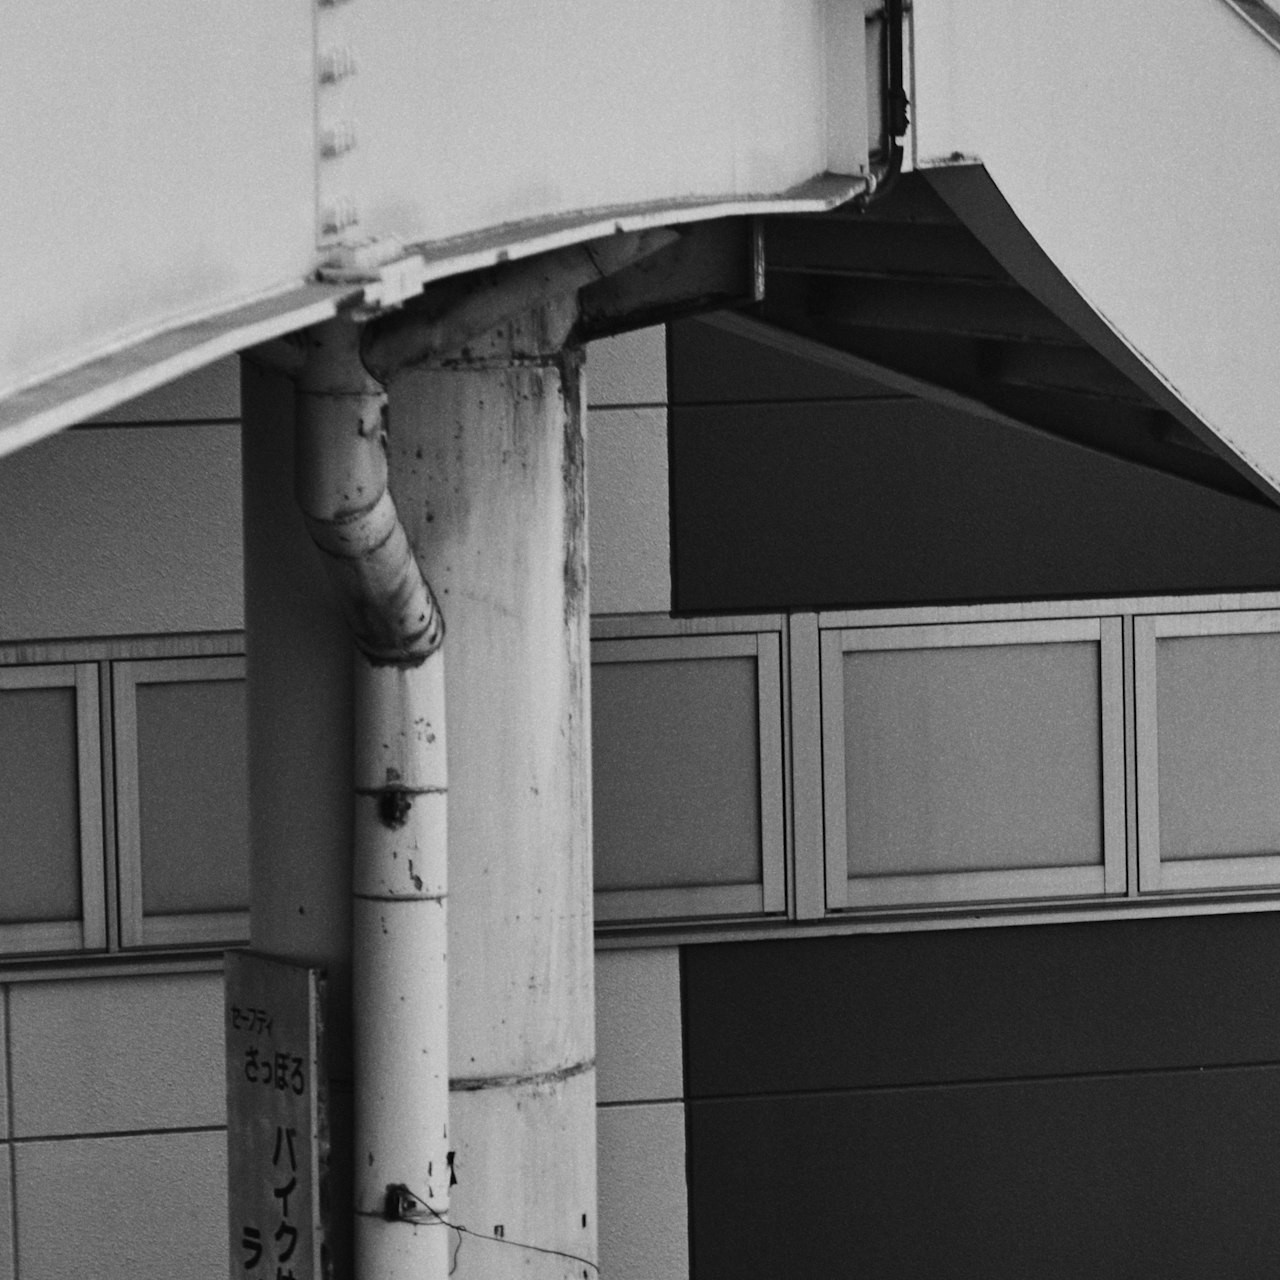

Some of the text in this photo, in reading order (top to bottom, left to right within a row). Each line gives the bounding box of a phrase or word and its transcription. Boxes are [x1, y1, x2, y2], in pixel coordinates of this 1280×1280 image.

[231, 1007, 274, 1037] セーフティ
[244, 1046, 306, 1096] さっぽろ
